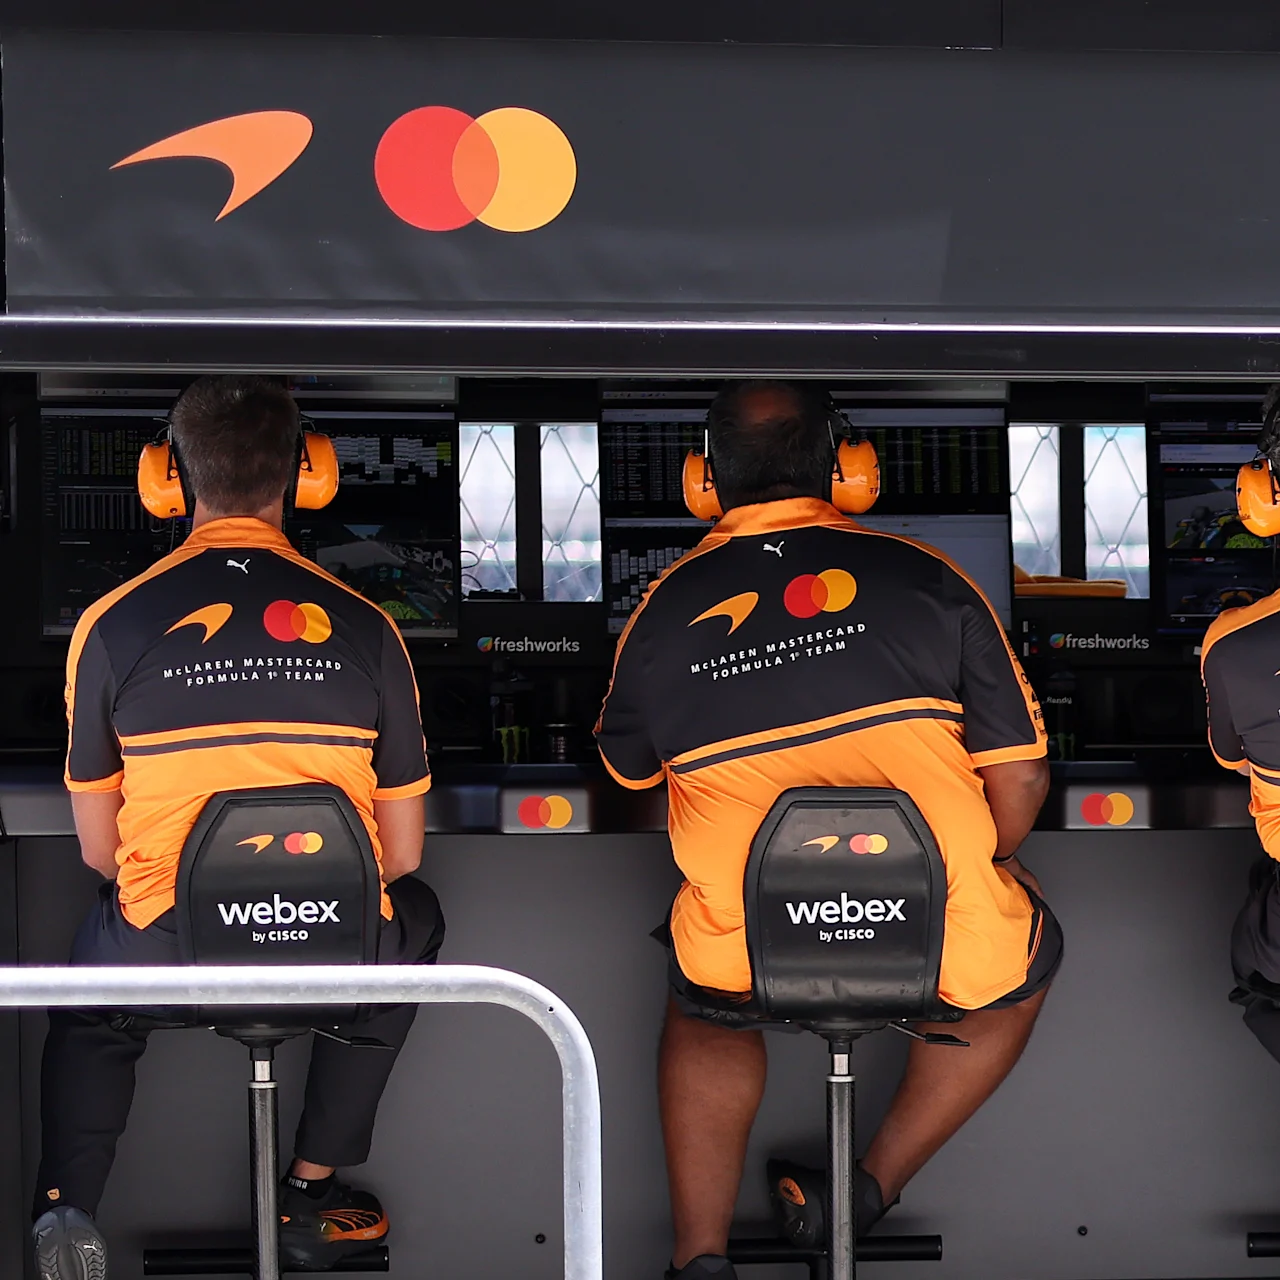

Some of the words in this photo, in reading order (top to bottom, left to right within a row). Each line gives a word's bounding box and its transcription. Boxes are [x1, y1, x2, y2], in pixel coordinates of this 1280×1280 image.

[493, 636, 580, 652] freshworks
[765, 623, 866, 653] MASTERCARD
[1065, 633, 1150, 649] freshworks
[243, 657, 342, 671] MASTERCARD
[712, 656, 783, 681] FORMULA
[805, 640, 846, 657] TEAM
[186, 671, 260, 687] FORMULA
[284, 671, 325, 682] TEAM
[217, 893, 341, 926] webex
[785, 892, 907, 925] webex
[252, 930, 267, 944] by
[268, 929, 309, 942] CISCO
[819, 929, 833, 943] by
[834, 928, 875, 941] CISCO
